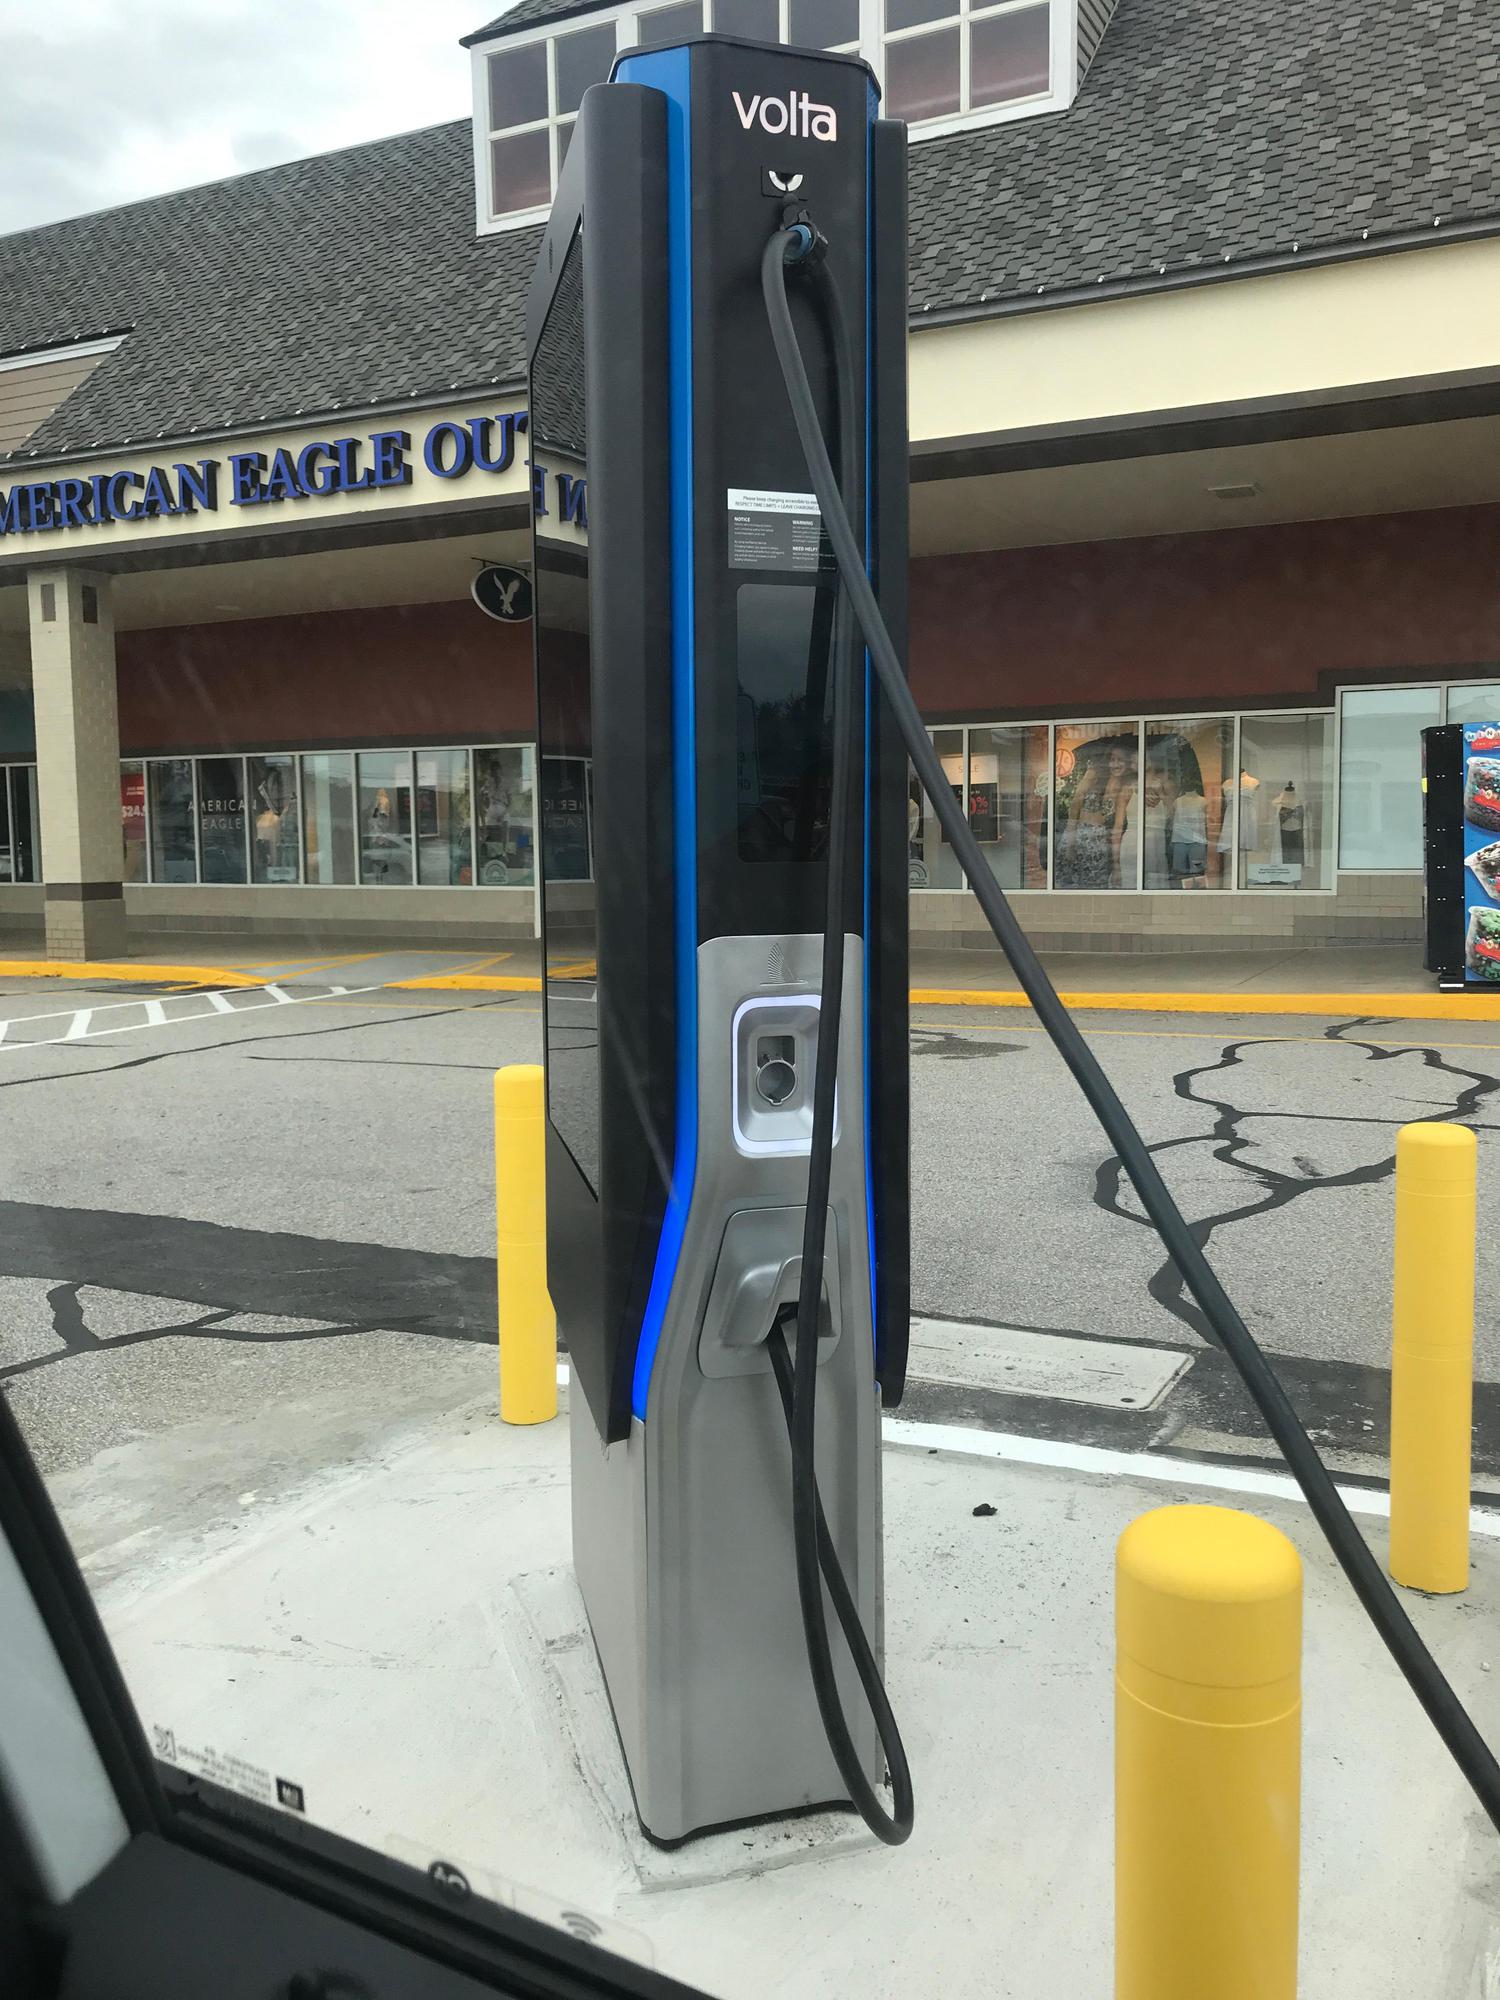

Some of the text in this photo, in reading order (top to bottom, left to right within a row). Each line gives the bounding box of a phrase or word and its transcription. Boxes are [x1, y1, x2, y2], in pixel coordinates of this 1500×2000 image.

[732, 91, 837, 141] volta
[229, 430, 413, 506] EAGLE
[202, 818, 241, 830] EAGLE
